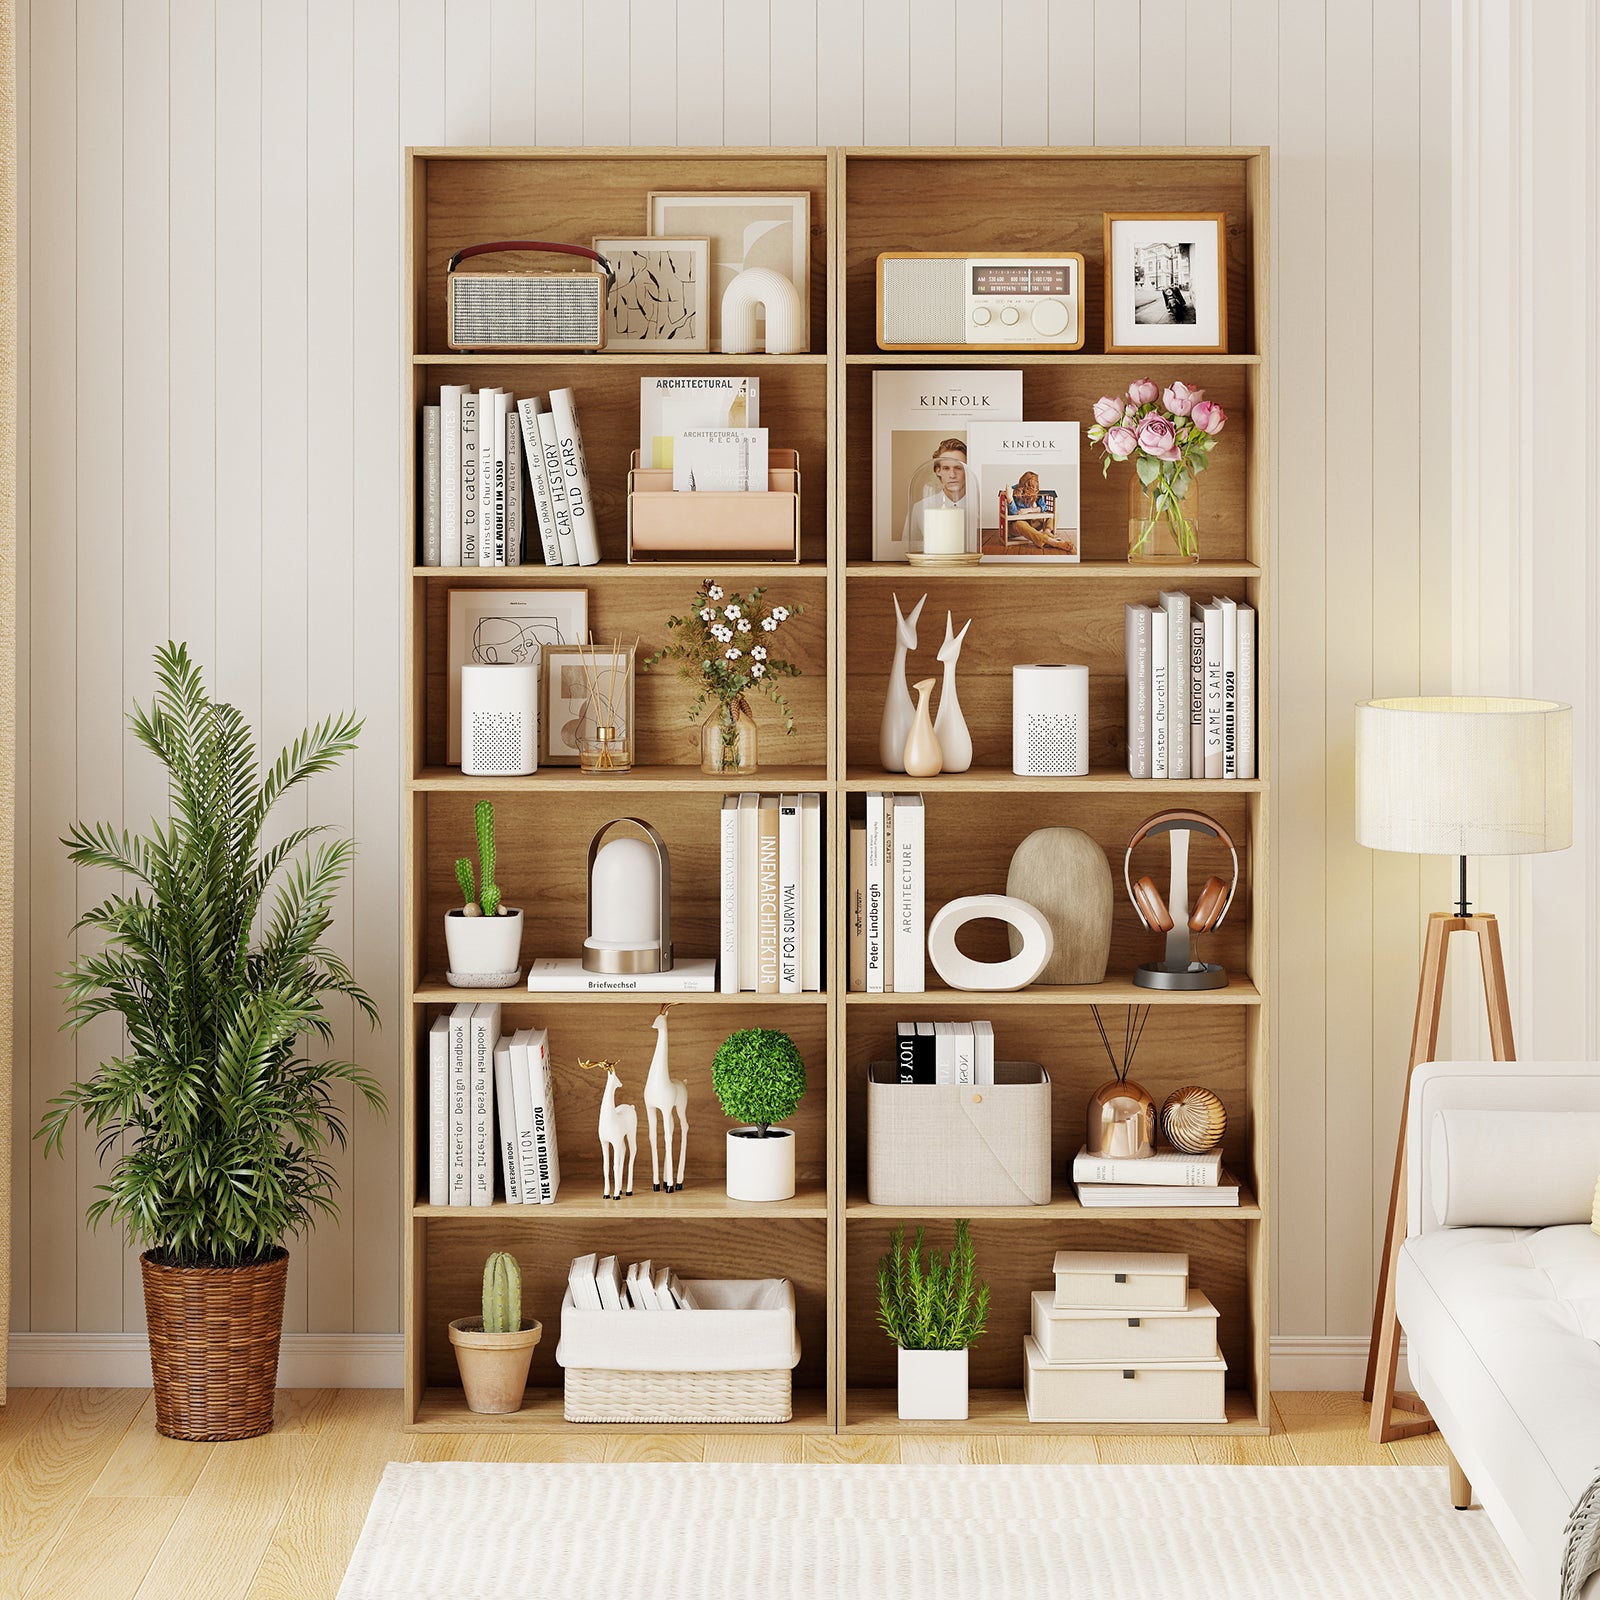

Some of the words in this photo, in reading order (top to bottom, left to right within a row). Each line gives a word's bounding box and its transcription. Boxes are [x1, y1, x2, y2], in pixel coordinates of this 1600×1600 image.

[656, 379, 733, 389] ARCHITECTURAL
[920, 395, 991, 406] KINFOLK
[463, 401, 475, 434] fish
[524, 403, 538, 447] children
[466, 443, 475, 451] a
[508, 414, 516, 456] Isaacson
[1002, 440, 1056, 449] KINFOLK
[545, 443, 564, 502] HISTORY
[560, 438, 578, 477] CARS
[464, 459, 475, 501] catch
[482, 447, 491, 506] Churchill
[508, 460, 516, 492] Walter
[538, 474, 546, 496] Book
[508, 496, 517, 506] by
[542, 500, 550, 524] DRAW
[569, 487, 585, 517] OLD
[464, 510, 475, 526] to
[508, 512, 516, 532] Jobs
[554, 510, 570, 536] CAR
[464, 534, 475, 559] How
[482, 512, 491, 559] Winston
[545, 527, 553, 540] TO
[508, 537, 516, 563] Steve
[549, 545, 557, 561] HOW
[1190, 627, 1204, 673] design
[1156, 666, 1165, 722] Churchill
[1209, 660, 1220, 699] SAME
[1226, 671, 1235, 699] 2020
[1190, 678, 1202, 725] Interior
[1226, 701, 1235, 712] IN
[1209, 708, 1220, 746] SAME
[1226, 714, 1235, 752] WORLD
[1156, 728, 1165, 771] Winston
[1226, 754, 1235, 774] THE
[726, 819, 734, 890] REVOLUTION
[902, 843, 912, 934] ARCHITECTURE
[726, 893, 734, 924] LOOK
[760, 836, 776, 984] INNENARCHITEKTUR
[783, 884, 795, 933] SURVIVAL
[870, 884, 881, 938] Lindbergh
[726, 929, 734, 952] NEW
[783, 936, 795, 959] FOR
[870, 941, 879, 970] Peter
[588, 981, 637, 989] Briefwechsel
[783, 963, 795, 983] ART
[454, 1026, 464, 1073] Handbook
[454, 1078, 466, 1114] Design
[534, 1106, 544, 1132] 2020
[454, 1120, 464, 1168] Interior
[537, 1134, 546, 1144] IN
[521, 1130, 537, 1200] INTUITION
[537, 1146, 549, 1180] WORLD
[454, 1173, 464, 1191] The
[540, 1182, 550, 1200] THE
